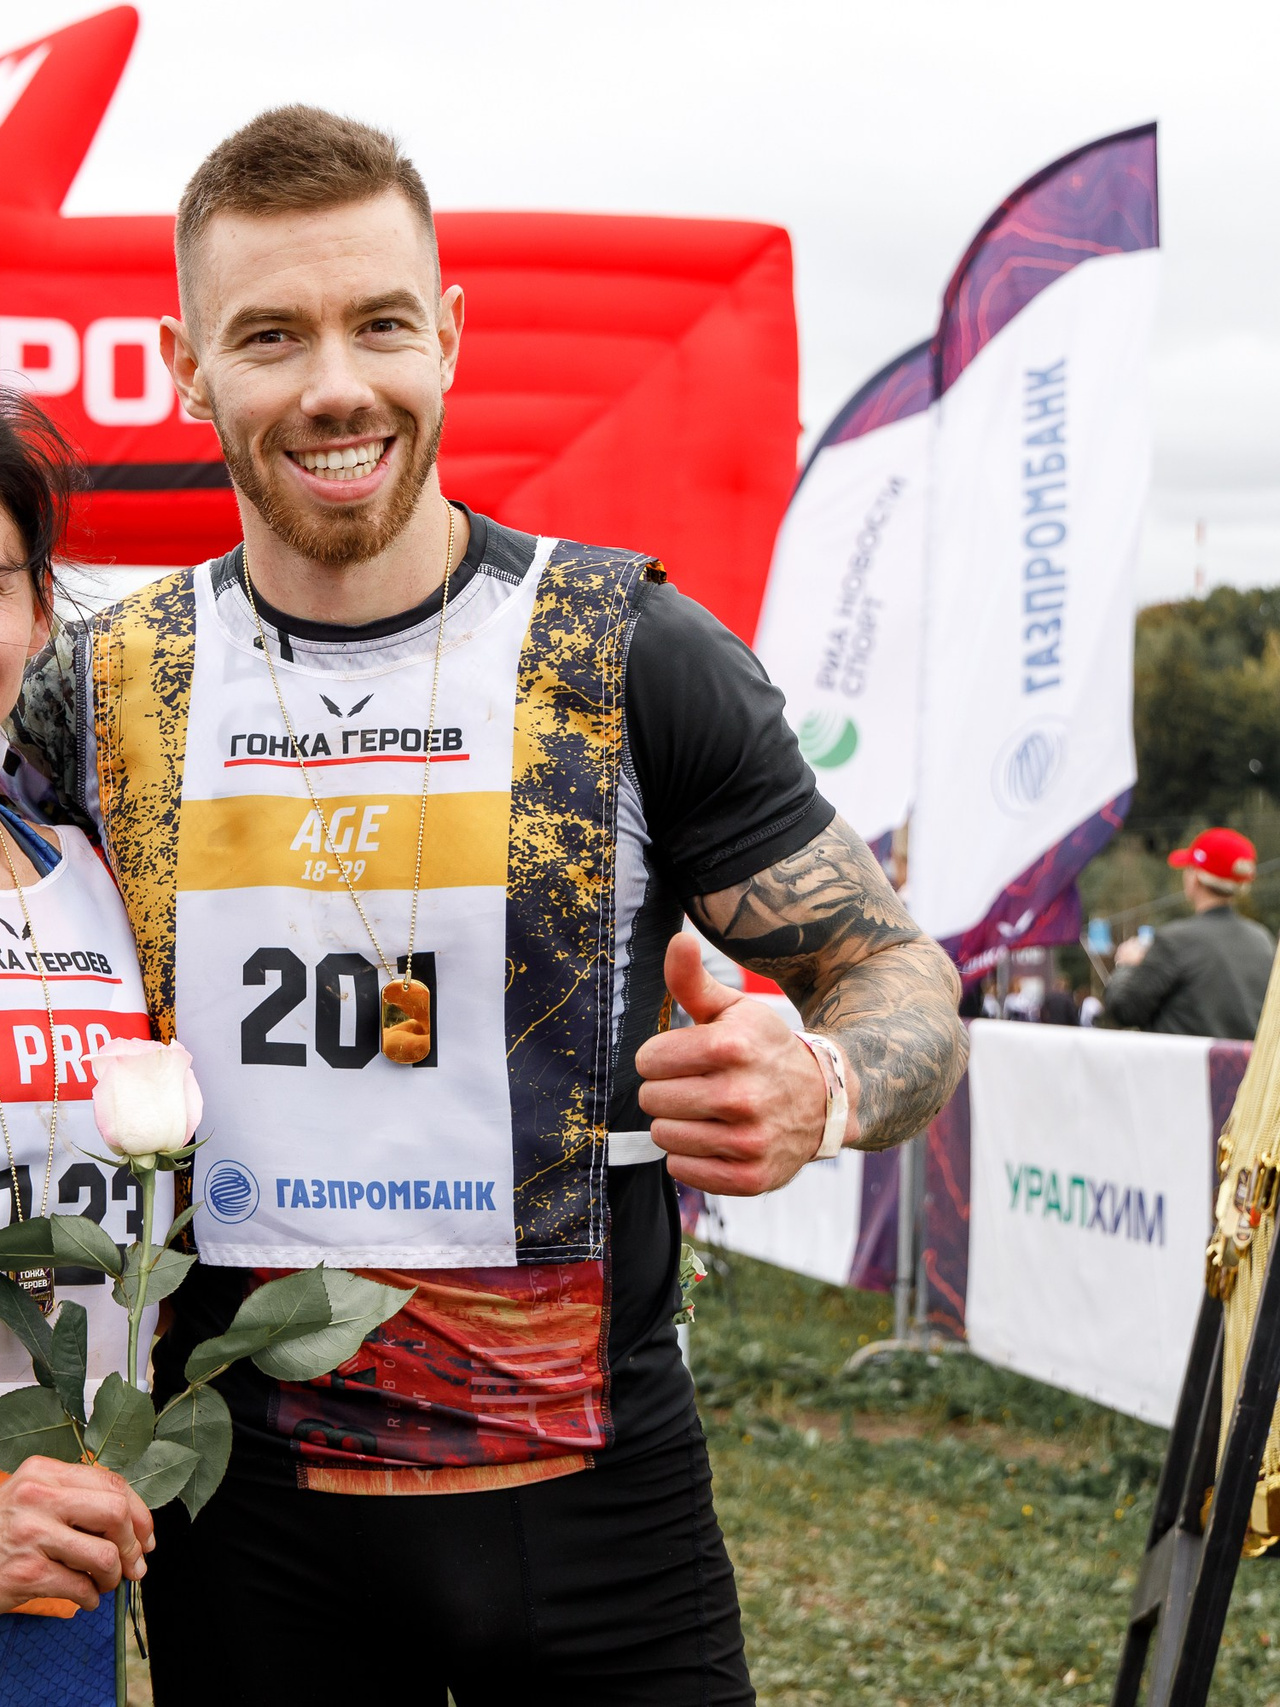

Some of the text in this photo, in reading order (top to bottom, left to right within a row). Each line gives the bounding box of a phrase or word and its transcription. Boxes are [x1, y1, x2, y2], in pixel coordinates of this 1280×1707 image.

[1022, 356, 1068, 695] ГАЗПРОМБАНК
[229, 727, 463, 758] ГОНКА ГЕРОЕВ
[289, 805, 389, 854] AGE
[25, 951, 113, 975] ГЕРОЕВ
[275, 1178, 497, 1211] ГАЗПРОМБАНК
[1004, 1160, 1165, 1246] УРАЛХИМ
[20, 1268, 45, 1279] ГОНКА
